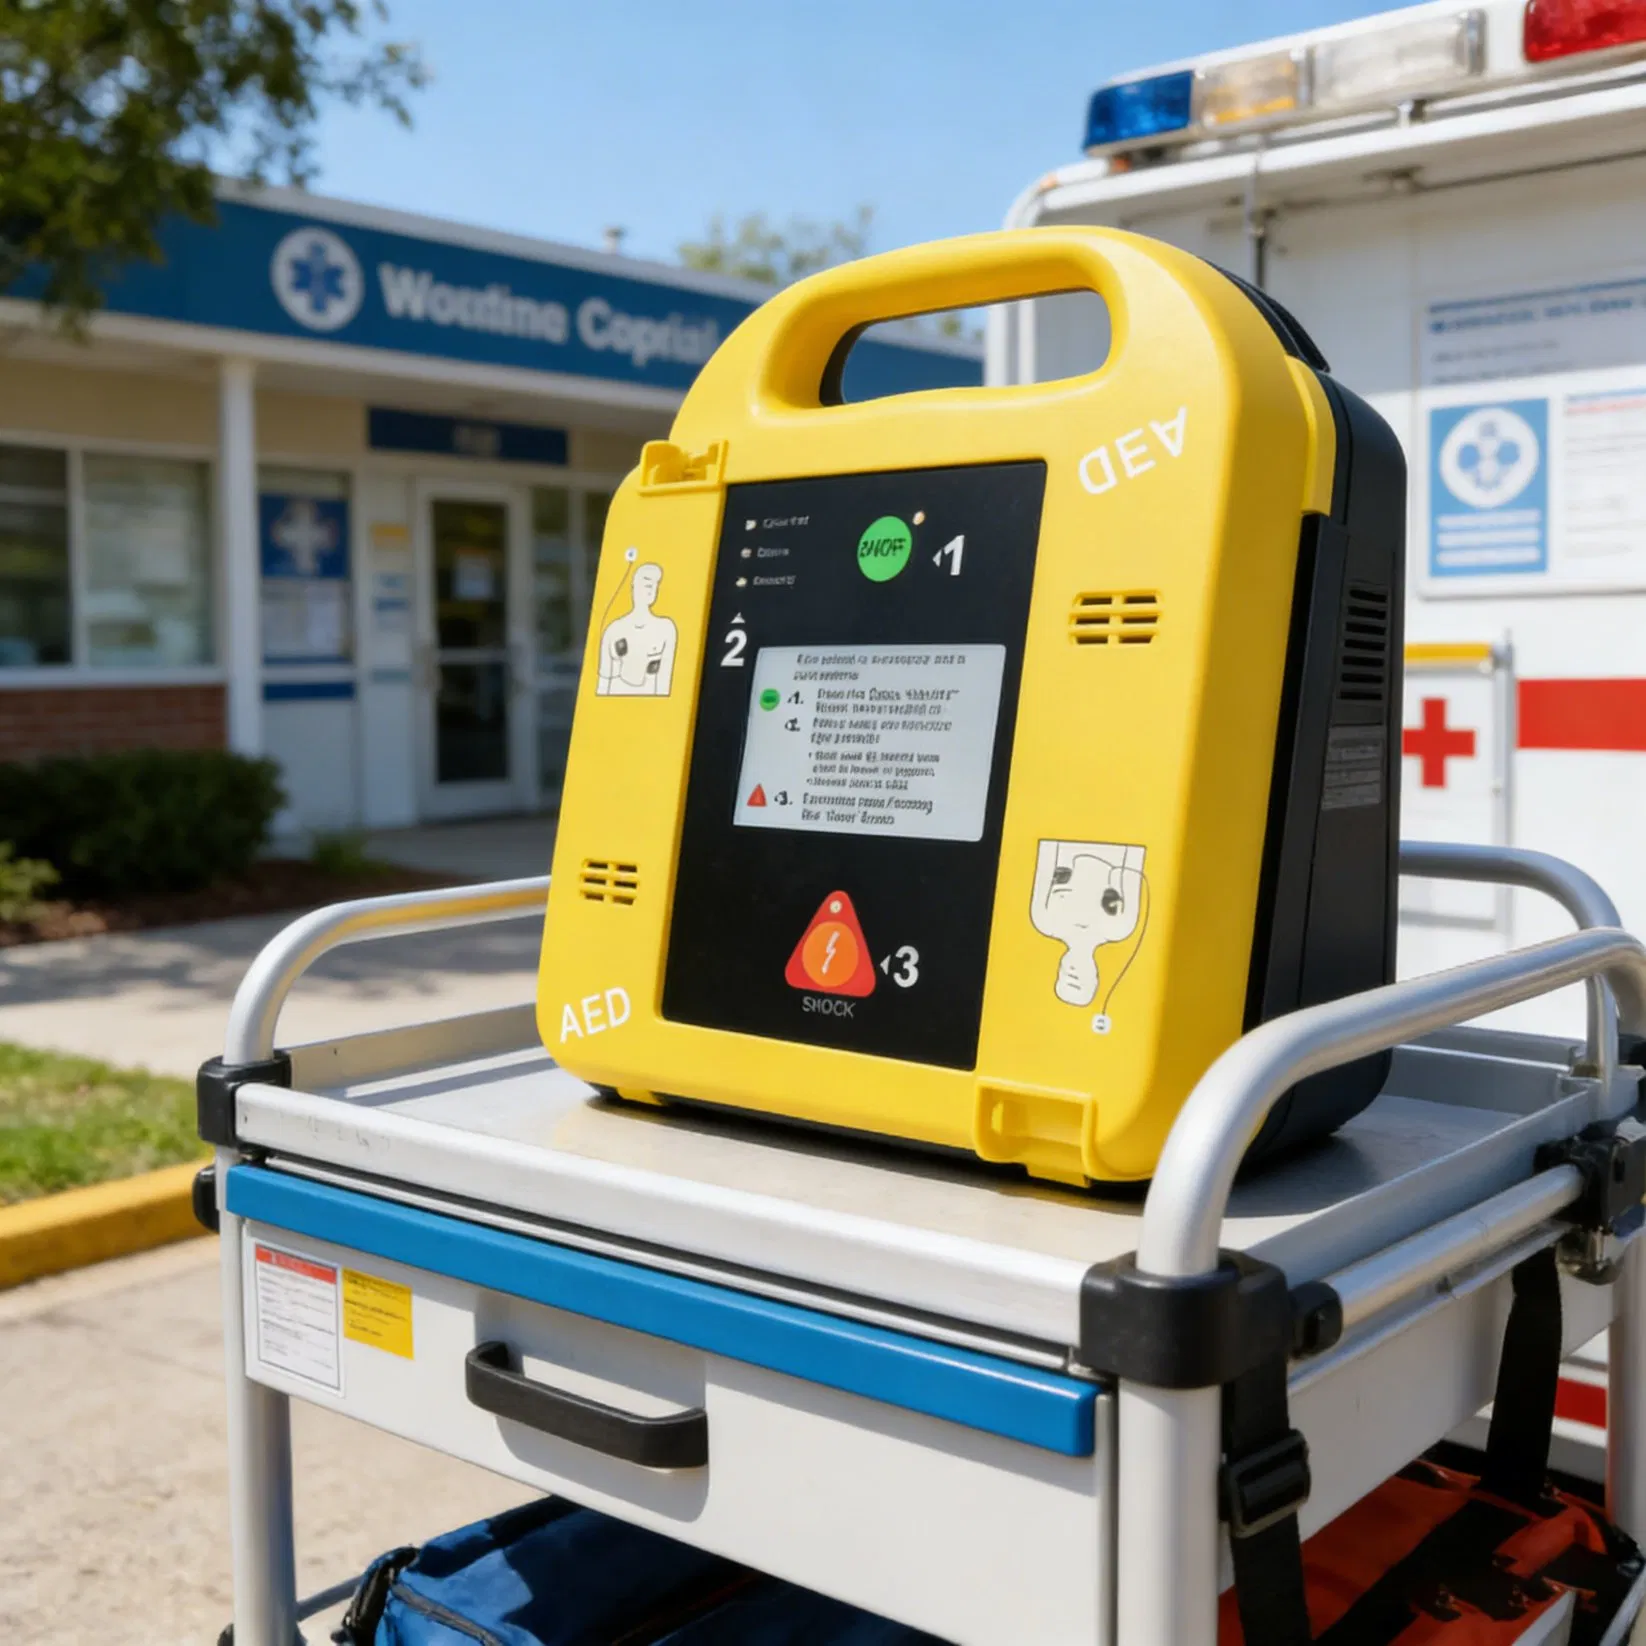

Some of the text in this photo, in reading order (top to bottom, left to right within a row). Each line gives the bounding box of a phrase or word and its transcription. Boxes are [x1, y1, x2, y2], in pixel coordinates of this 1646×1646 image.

[944, 534, 965, 576] 1
[720, 630, 747, 666] 2
[893, 945, 919, 988] 3
[559, 987, 631, 1043] AED
[802, 996, 856, 1018] SHOCK
